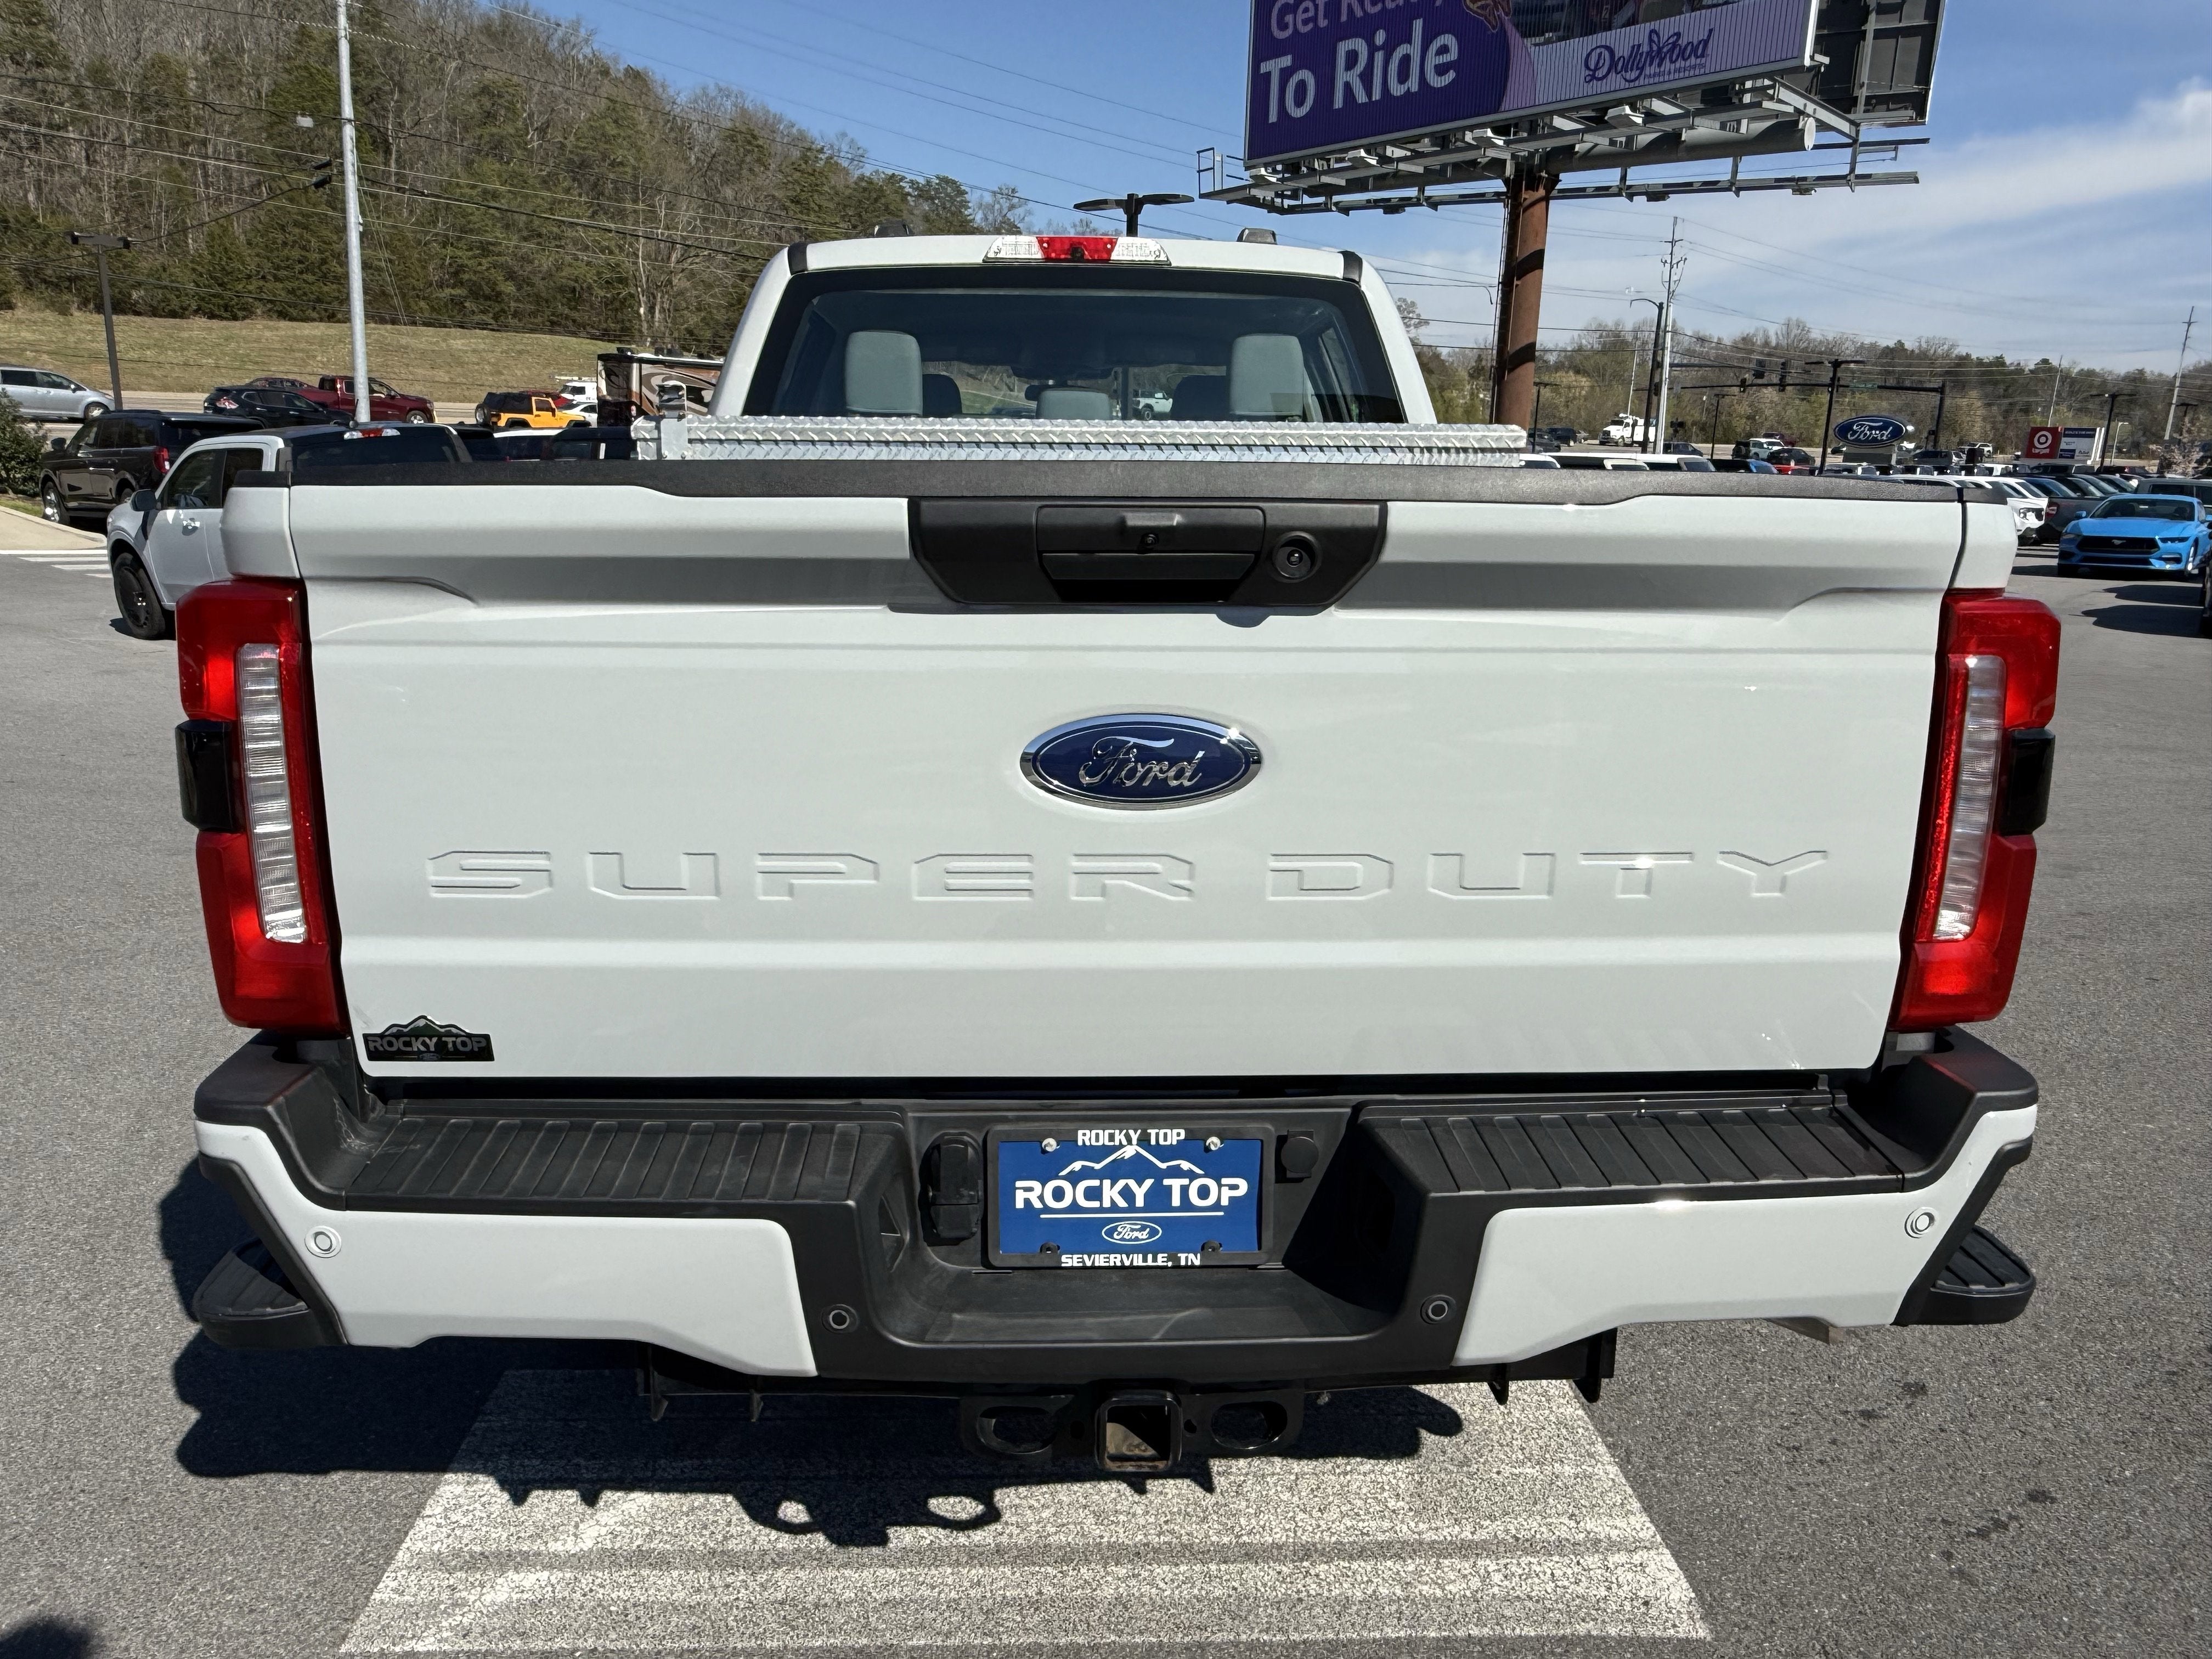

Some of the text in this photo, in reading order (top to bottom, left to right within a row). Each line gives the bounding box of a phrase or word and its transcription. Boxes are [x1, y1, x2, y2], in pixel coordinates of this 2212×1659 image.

[1271, 0, 1329, 40] Get
[1260, 18, 1459, 123] To Ride
[1584, 28, 1714, 83] Dollywood
[1847, 421, 1893, 440] Ford
[1078, 736, 1206, 788] Ford
[426, 850, 1829, 901] SUPER DUTY
[366, 1036, 487, 1052] ROCKY TOP
[1077, 1128, 1186, 1146] ROCKY TOP
[1014, 1177, 1249, 1209] ROCKY TOP
[1113, 1223, 1150, 1239] Ford
[1060, 1252, 1201, 1267] SEVIERVILLE, TN
